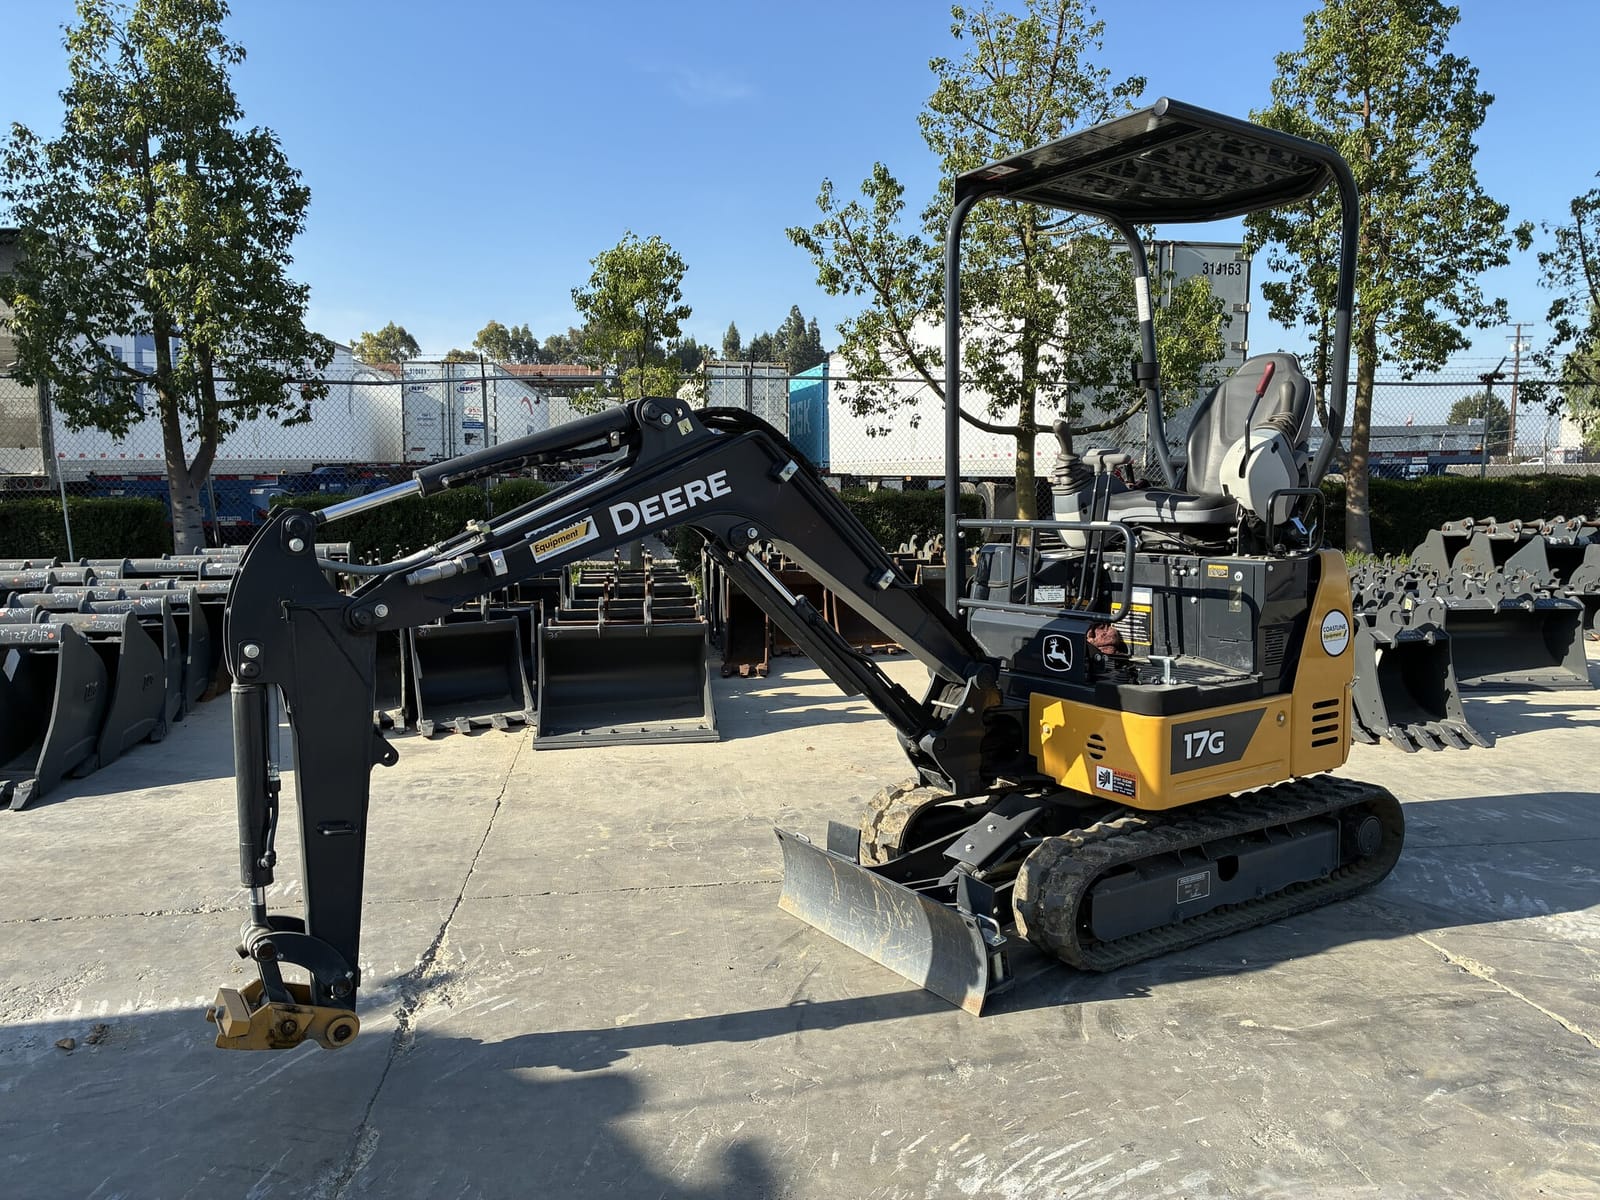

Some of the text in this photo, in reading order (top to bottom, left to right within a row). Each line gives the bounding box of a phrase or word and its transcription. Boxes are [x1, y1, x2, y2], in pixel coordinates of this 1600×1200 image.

[608, 469, 733, 536] DEERE
[534, 529, 579, 553] Equipment
[9, 629, 48, 642] 127843
[1323, 624, 1346, 632] COASTLINE
[1184, 730, 1225, 759] 17G
